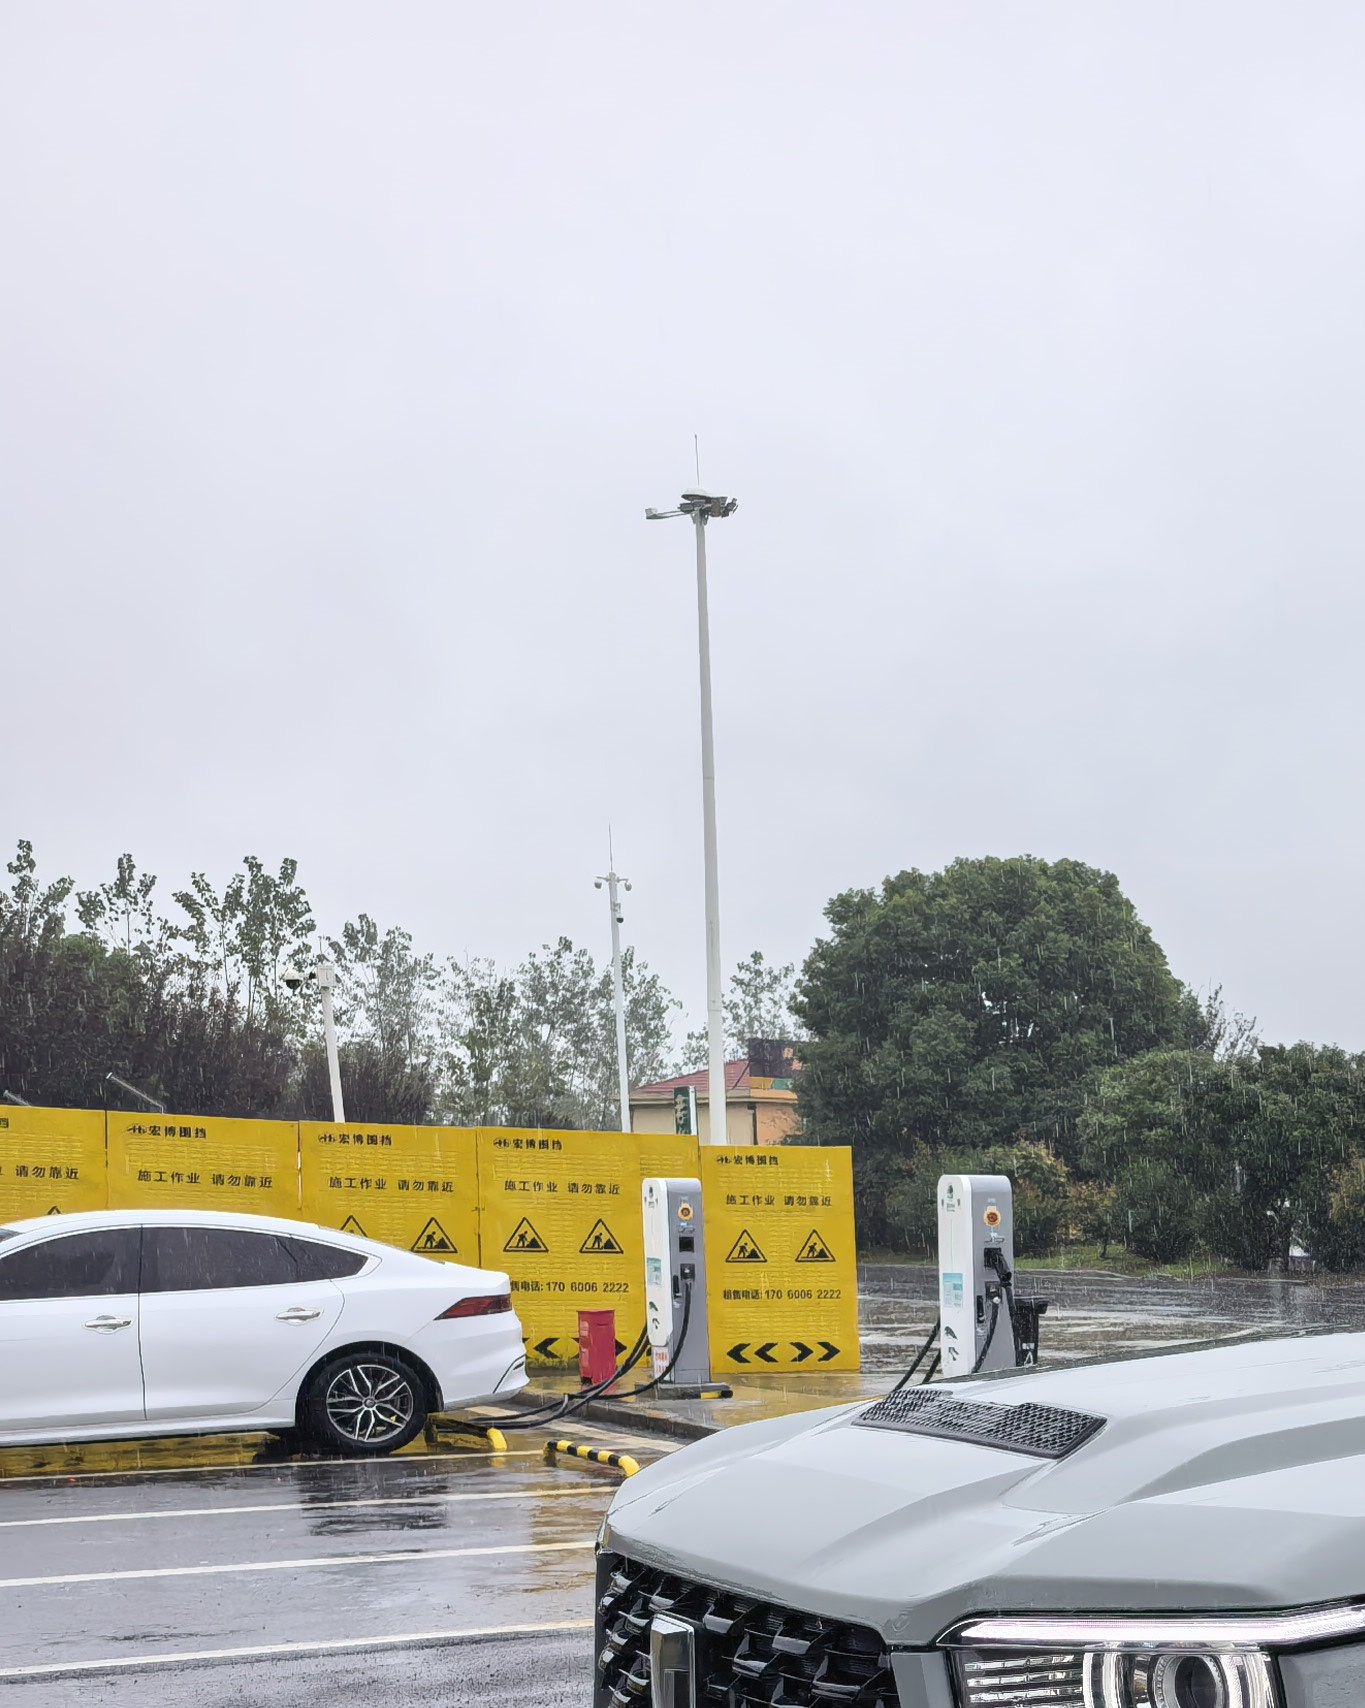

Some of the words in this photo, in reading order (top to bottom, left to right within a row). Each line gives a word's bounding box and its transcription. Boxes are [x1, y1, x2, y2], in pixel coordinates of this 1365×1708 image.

[15, 1165, 79, 1180] 请勿靠近
[137, 1169, 201, 1185] 施工作业
[212, 1173, 273, 1188] 请勿靠近
[329, 1176, 387, 1190] 施工作业
[397, 1179, 454, 1193] 请勿靠近
[504, 1180, 558, 1193] 施工作业
[567, 1182, 620, 1195] 请勿靠近
[726, 1194, 775, 1206] 施工作业
[784, 1195, 832, 1207] 请勿靠近
[511, 1280, 544, 1292] 售电话:
[546, 1282, 565, 1292] 170
[571, 1281, 598, 1292] 6006
[603, 1282, 629, 1293] 2222
[765, 1290, 783, 1299] 170
[787, 1290, 813, 1299] 6006
[817, 1289, 841, 1300] 2222
